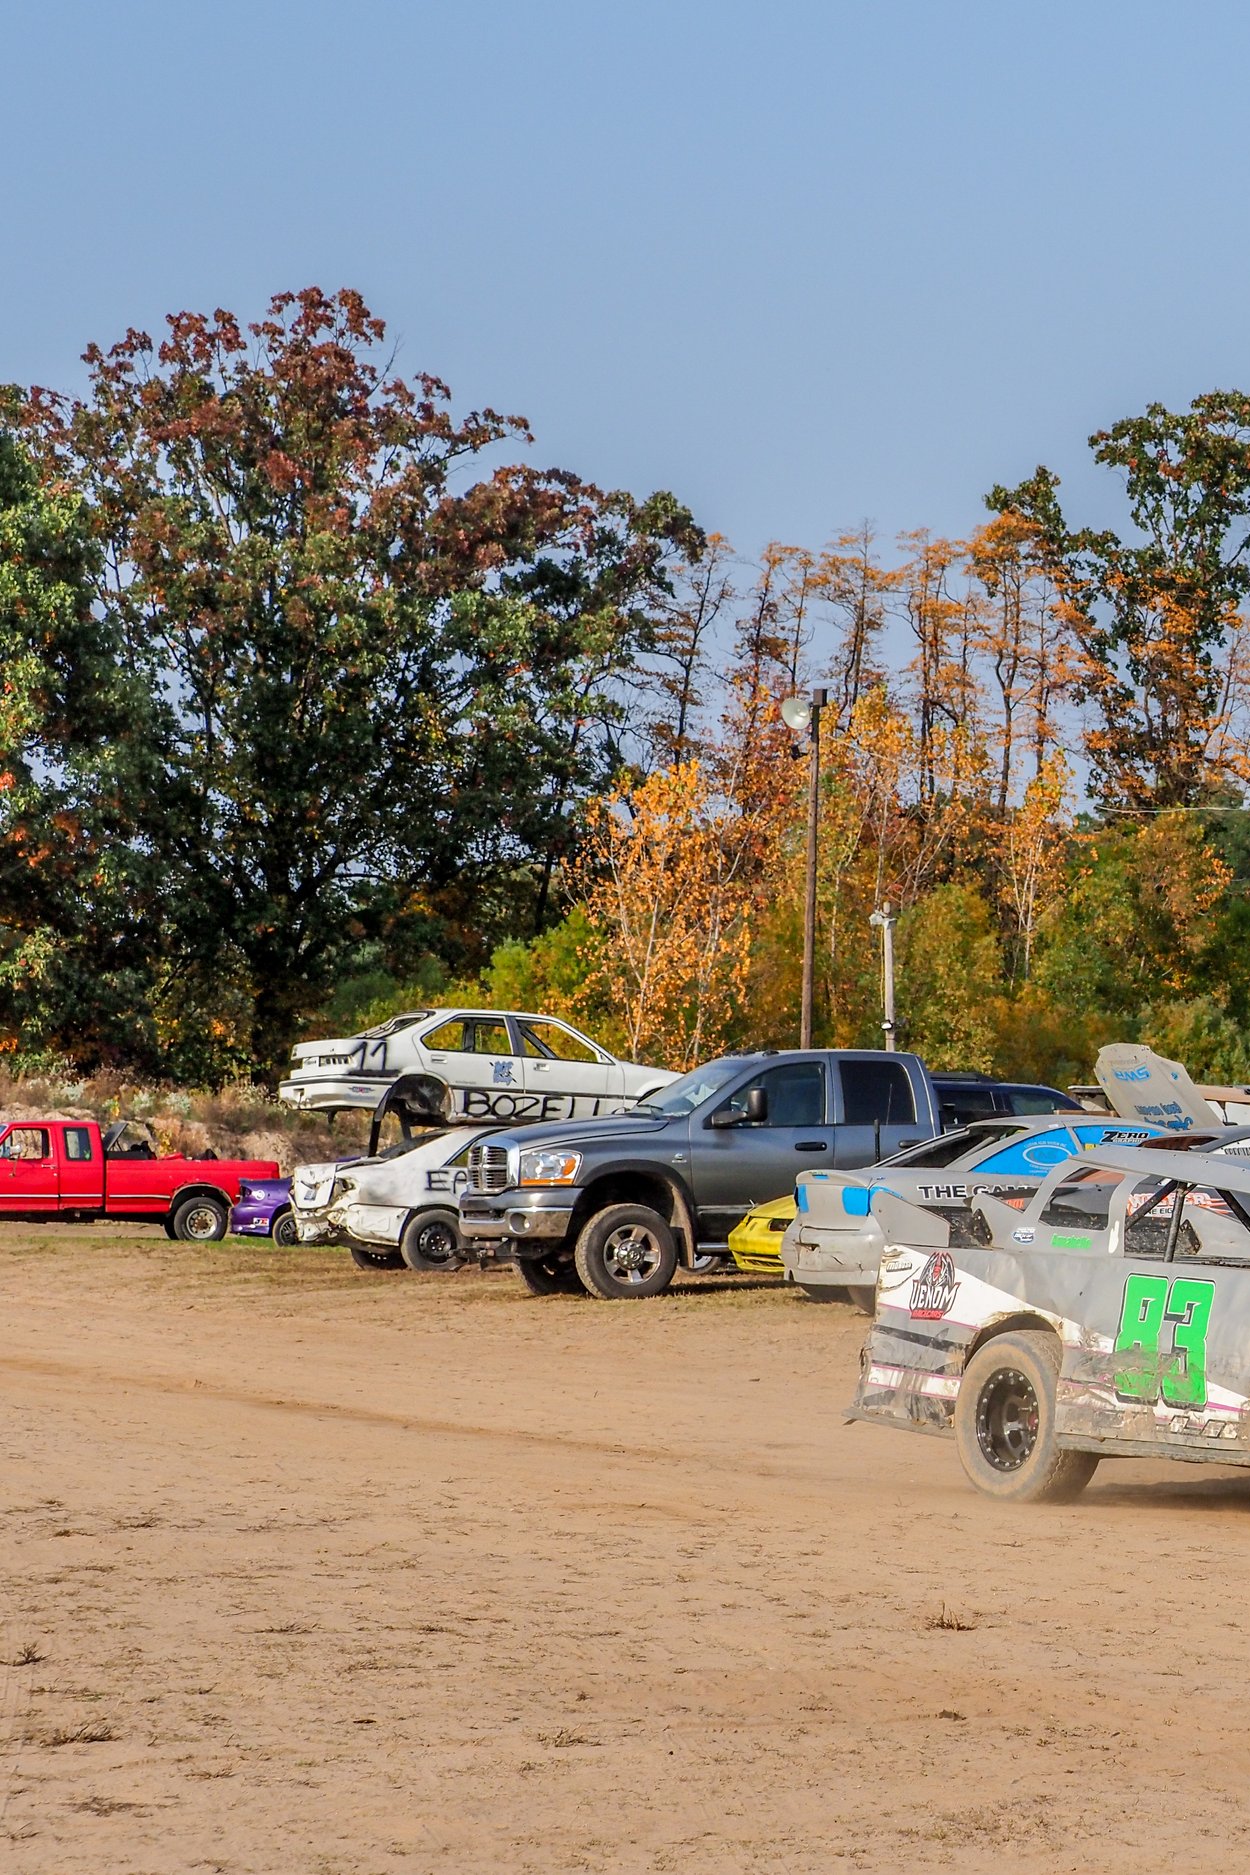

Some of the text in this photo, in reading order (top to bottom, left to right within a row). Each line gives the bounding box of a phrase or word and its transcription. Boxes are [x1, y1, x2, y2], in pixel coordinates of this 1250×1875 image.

[1101, 1131, 1149, 1143] ZERO
[918, 1185, 967, 1199] THE
[1113, 1272, 1216, 1412] 83
